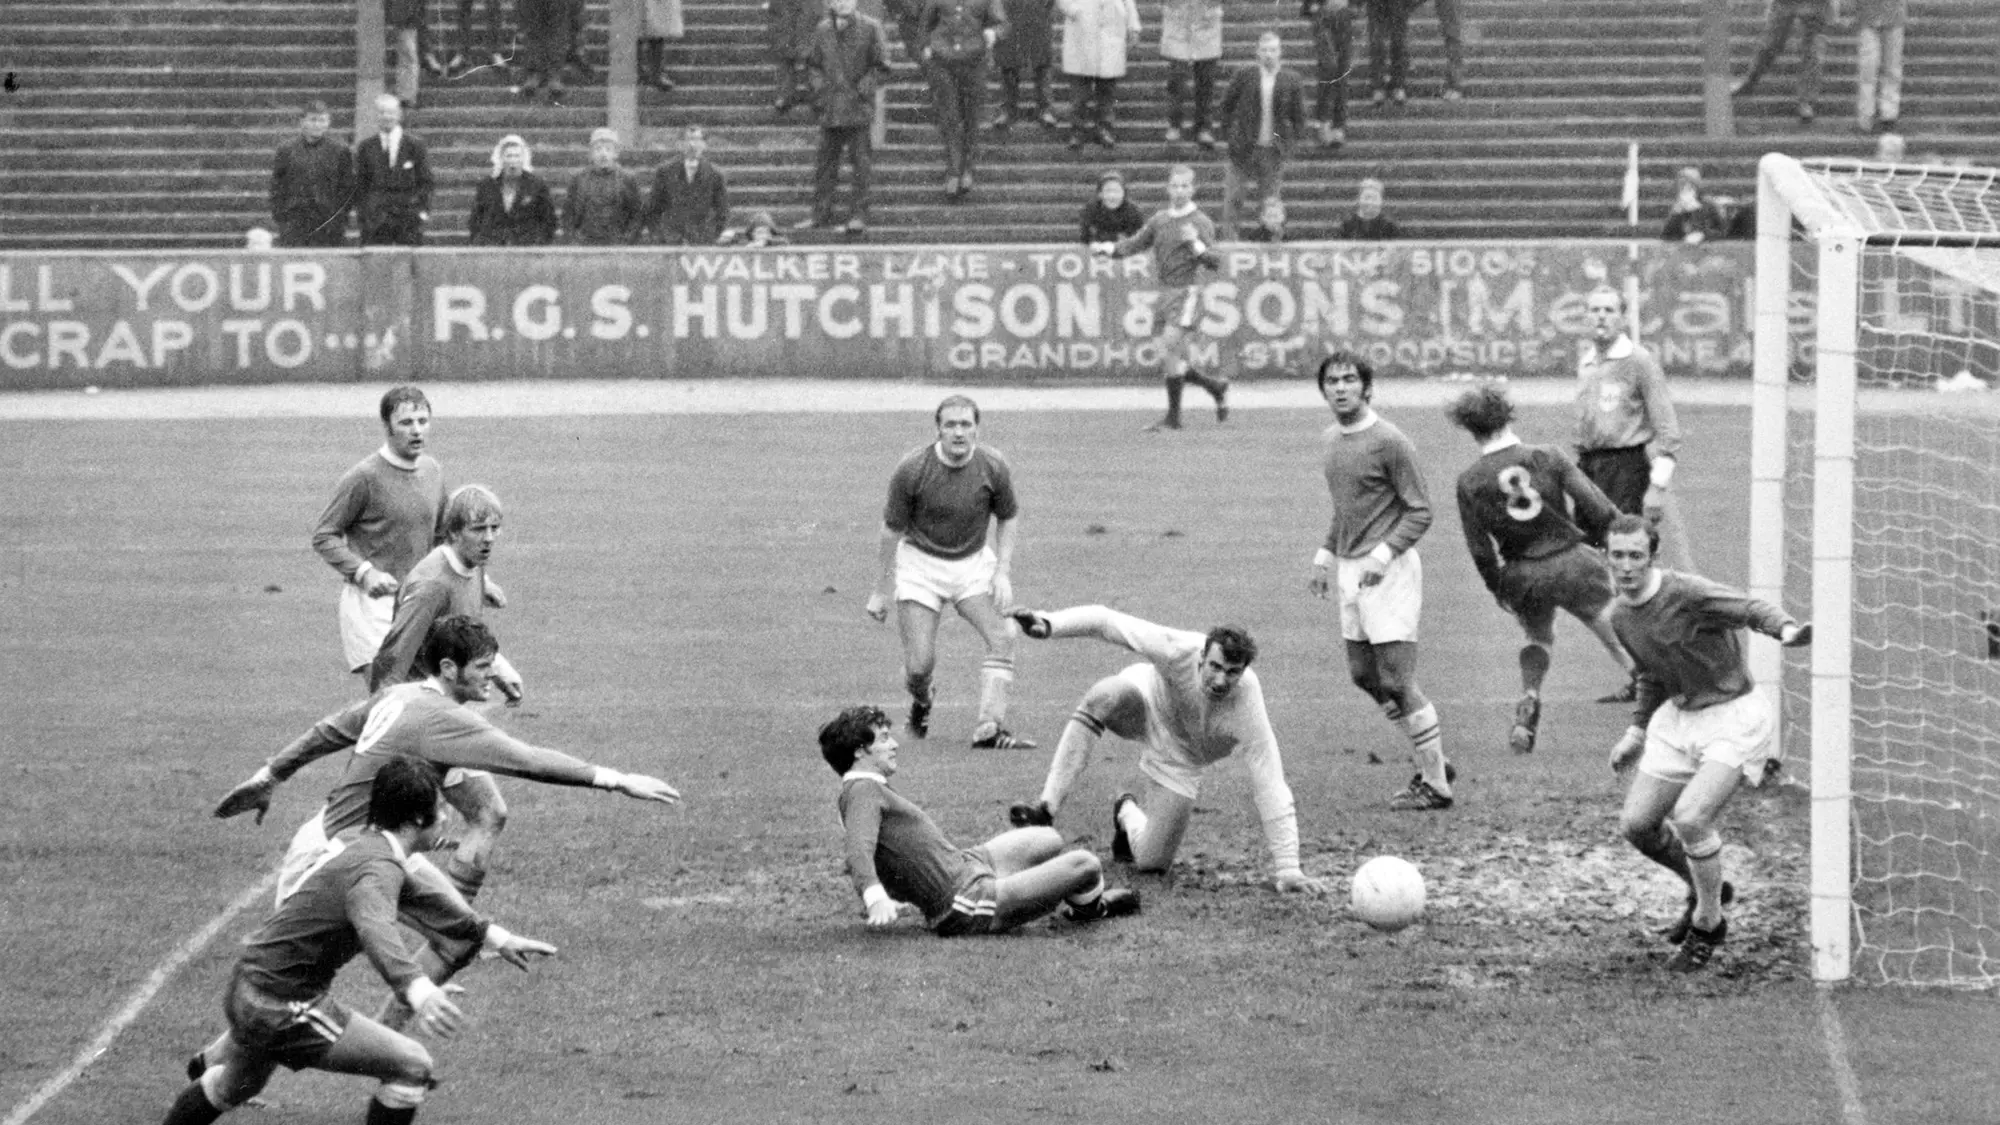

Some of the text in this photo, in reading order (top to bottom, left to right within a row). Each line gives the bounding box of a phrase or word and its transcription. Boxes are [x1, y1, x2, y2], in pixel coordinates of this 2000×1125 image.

[109, 262, 327, 312] YOUR
[679, 253, 862, 280] WALKER
[883, 253, 990, 280] LANE
[1027, 253, 1153, 279] TORR
[672, 282, 1101, 340] HUTCHISON
[1199, 280, 1404, 337] SONS
[0, 319, 194, 370] CRAP
[948, 341, 1220, 370] GRANDHOM
[1497, 465, 1543, 522] 8
